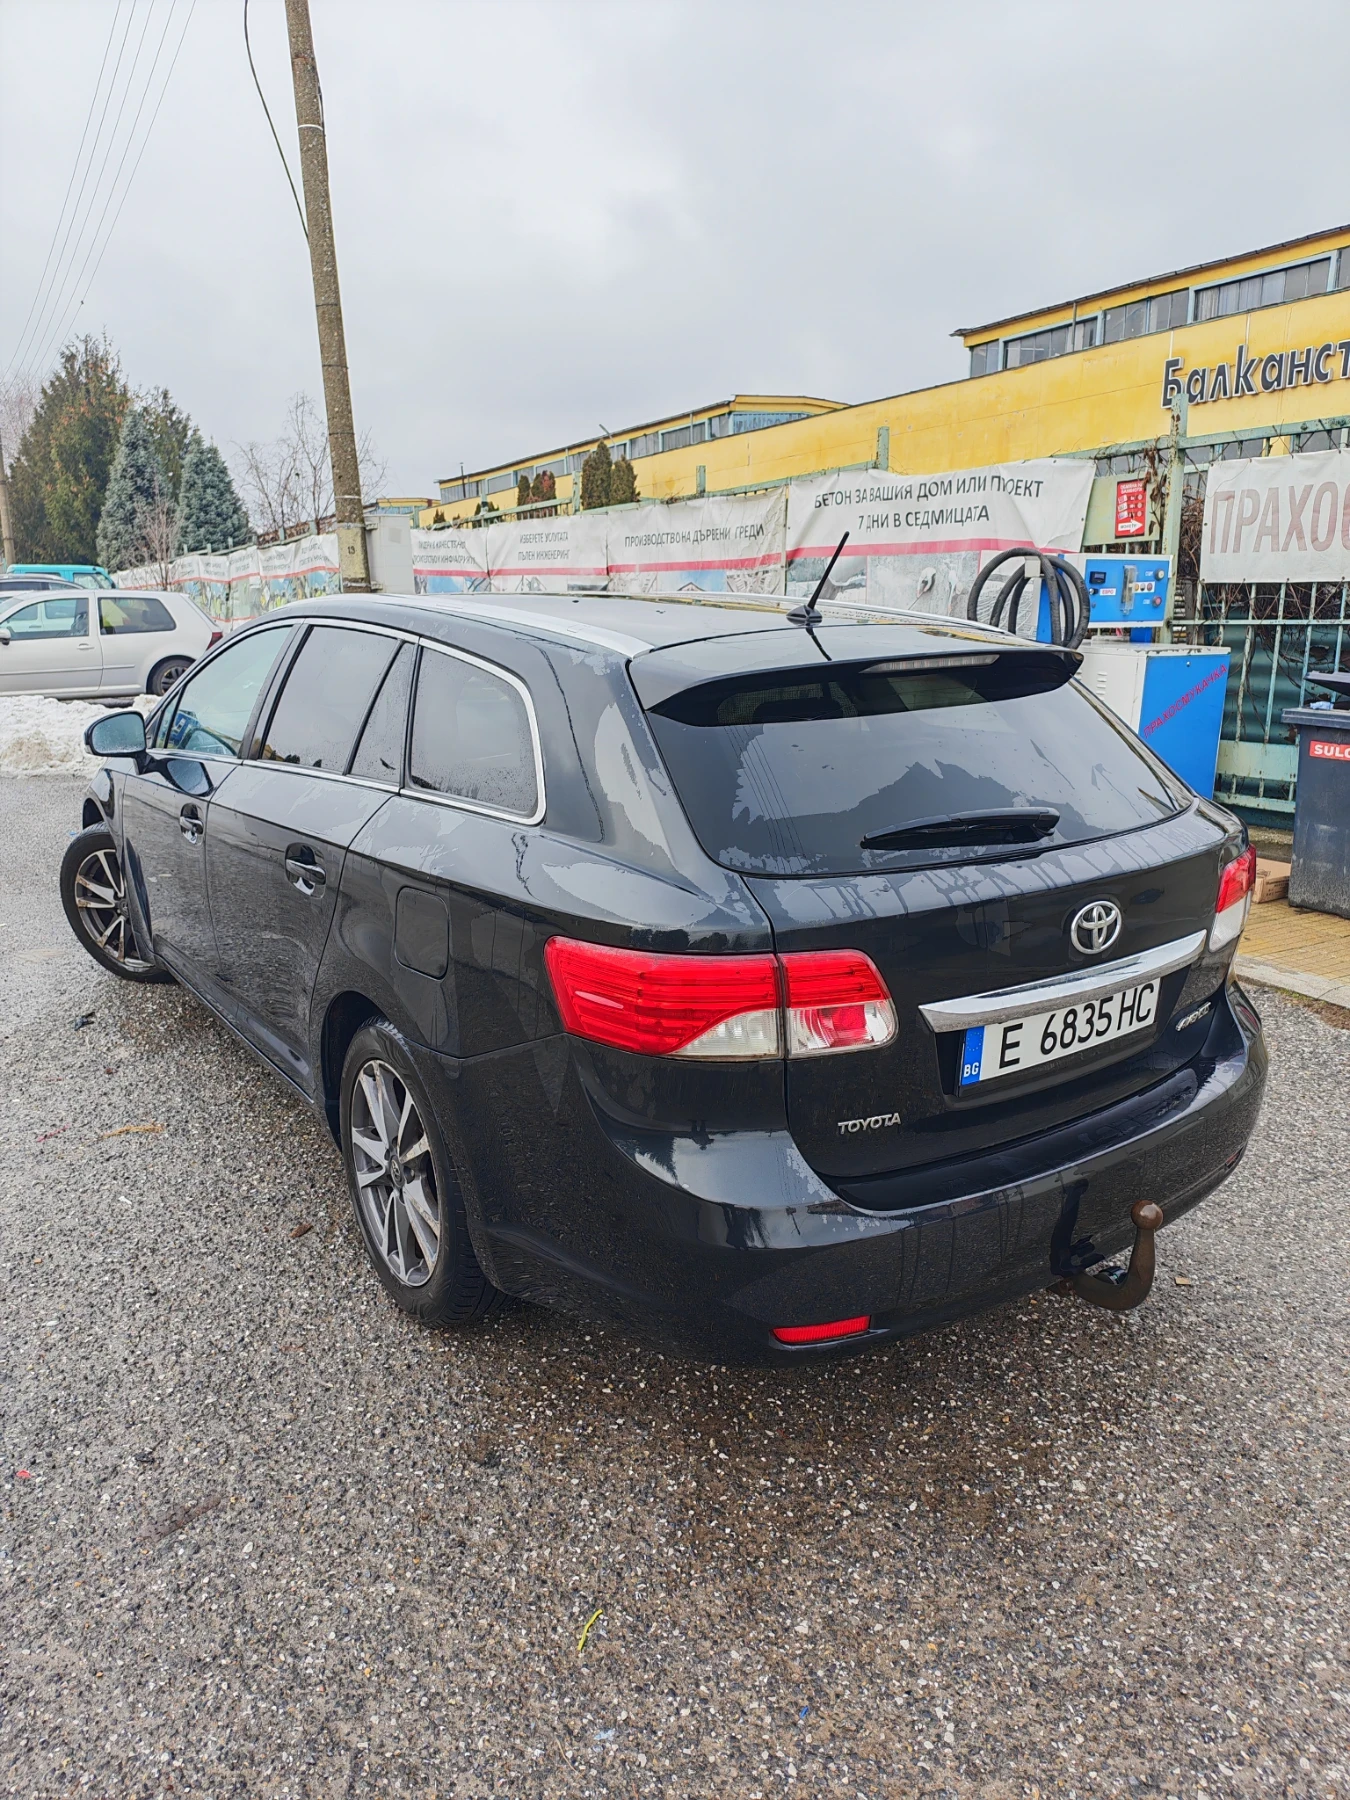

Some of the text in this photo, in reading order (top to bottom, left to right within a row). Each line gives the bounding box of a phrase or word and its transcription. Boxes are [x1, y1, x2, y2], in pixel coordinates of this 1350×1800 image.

[814, 489, 851, 508] БЕТОН
[917, 479, 952, 502] ДОМ
[956, 476, 987, 494] ИЛИ
[858, 504, 990, 533] 7 ДНИ В СЕДМИЦАТА
[624, 523, 765, 548] ПРОИЗВОДСТВО НА ДЪРВЕНИ ГРЕДИ
[1143, 663, 1228, 740] ПРАХОСМУКАЧКА
[999, 1022, 1024, 1069] E
[963, 1061, 980, 1078] BG
[837, 1112, 902, 1135] TOYOTA
